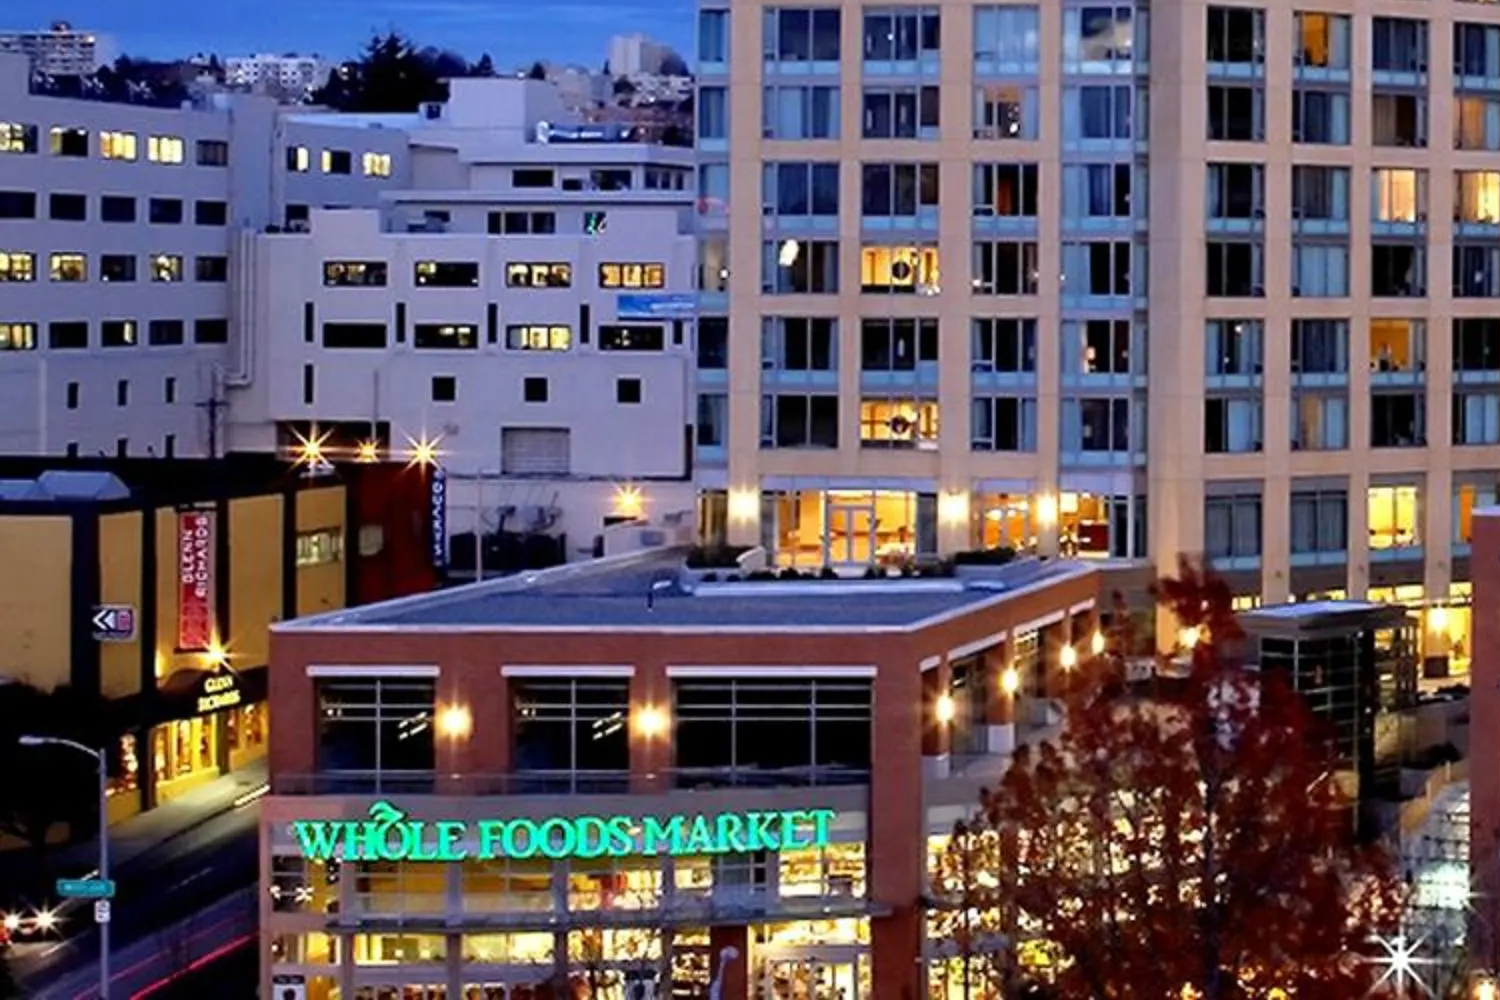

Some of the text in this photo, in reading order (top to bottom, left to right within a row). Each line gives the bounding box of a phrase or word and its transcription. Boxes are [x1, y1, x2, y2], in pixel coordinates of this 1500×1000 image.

[293, 802, 835, 861] WHOLE FOODS MARKET
